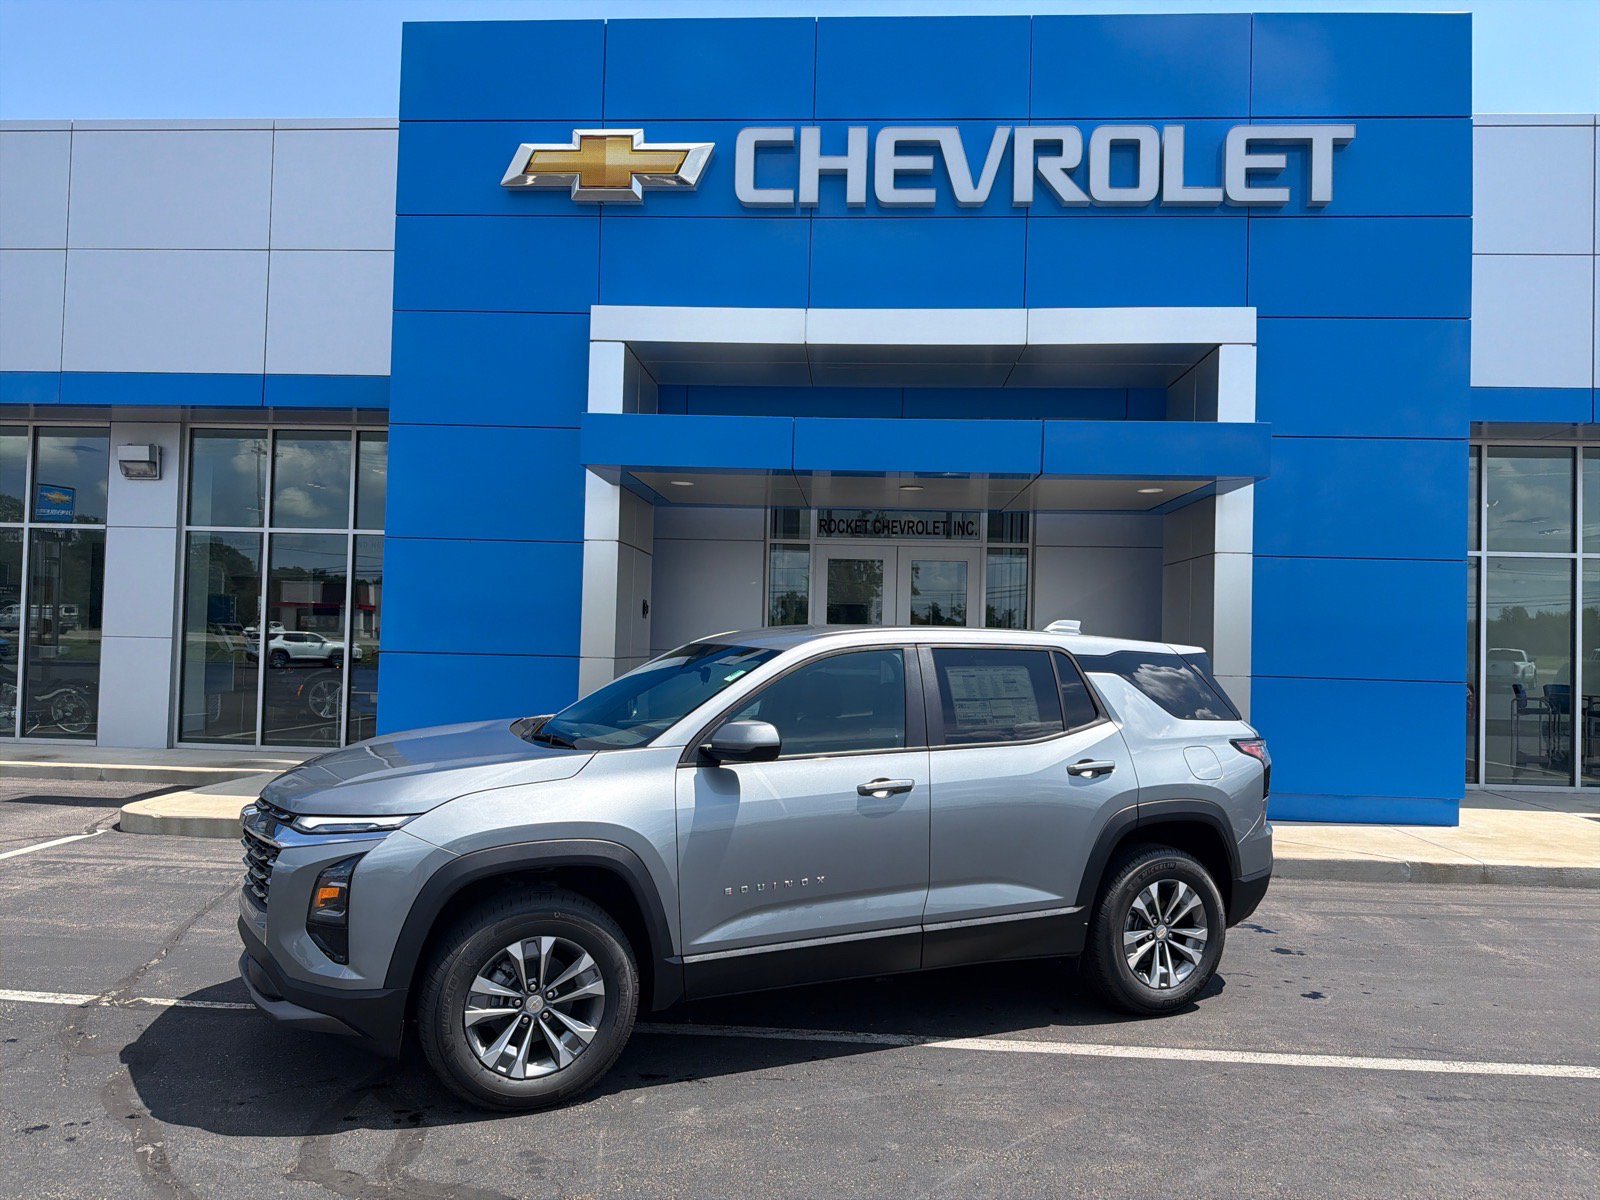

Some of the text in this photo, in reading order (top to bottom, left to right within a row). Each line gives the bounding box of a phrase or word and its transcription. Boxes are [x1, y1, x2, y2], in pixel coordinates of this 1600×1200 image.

[735, 124, 1356, 206] CHEVROLET
[818, 518, 869, 535] ROCKET
[953, 521, 978, 536] INC.
[724, 876, 825, 895] EQUINOX
